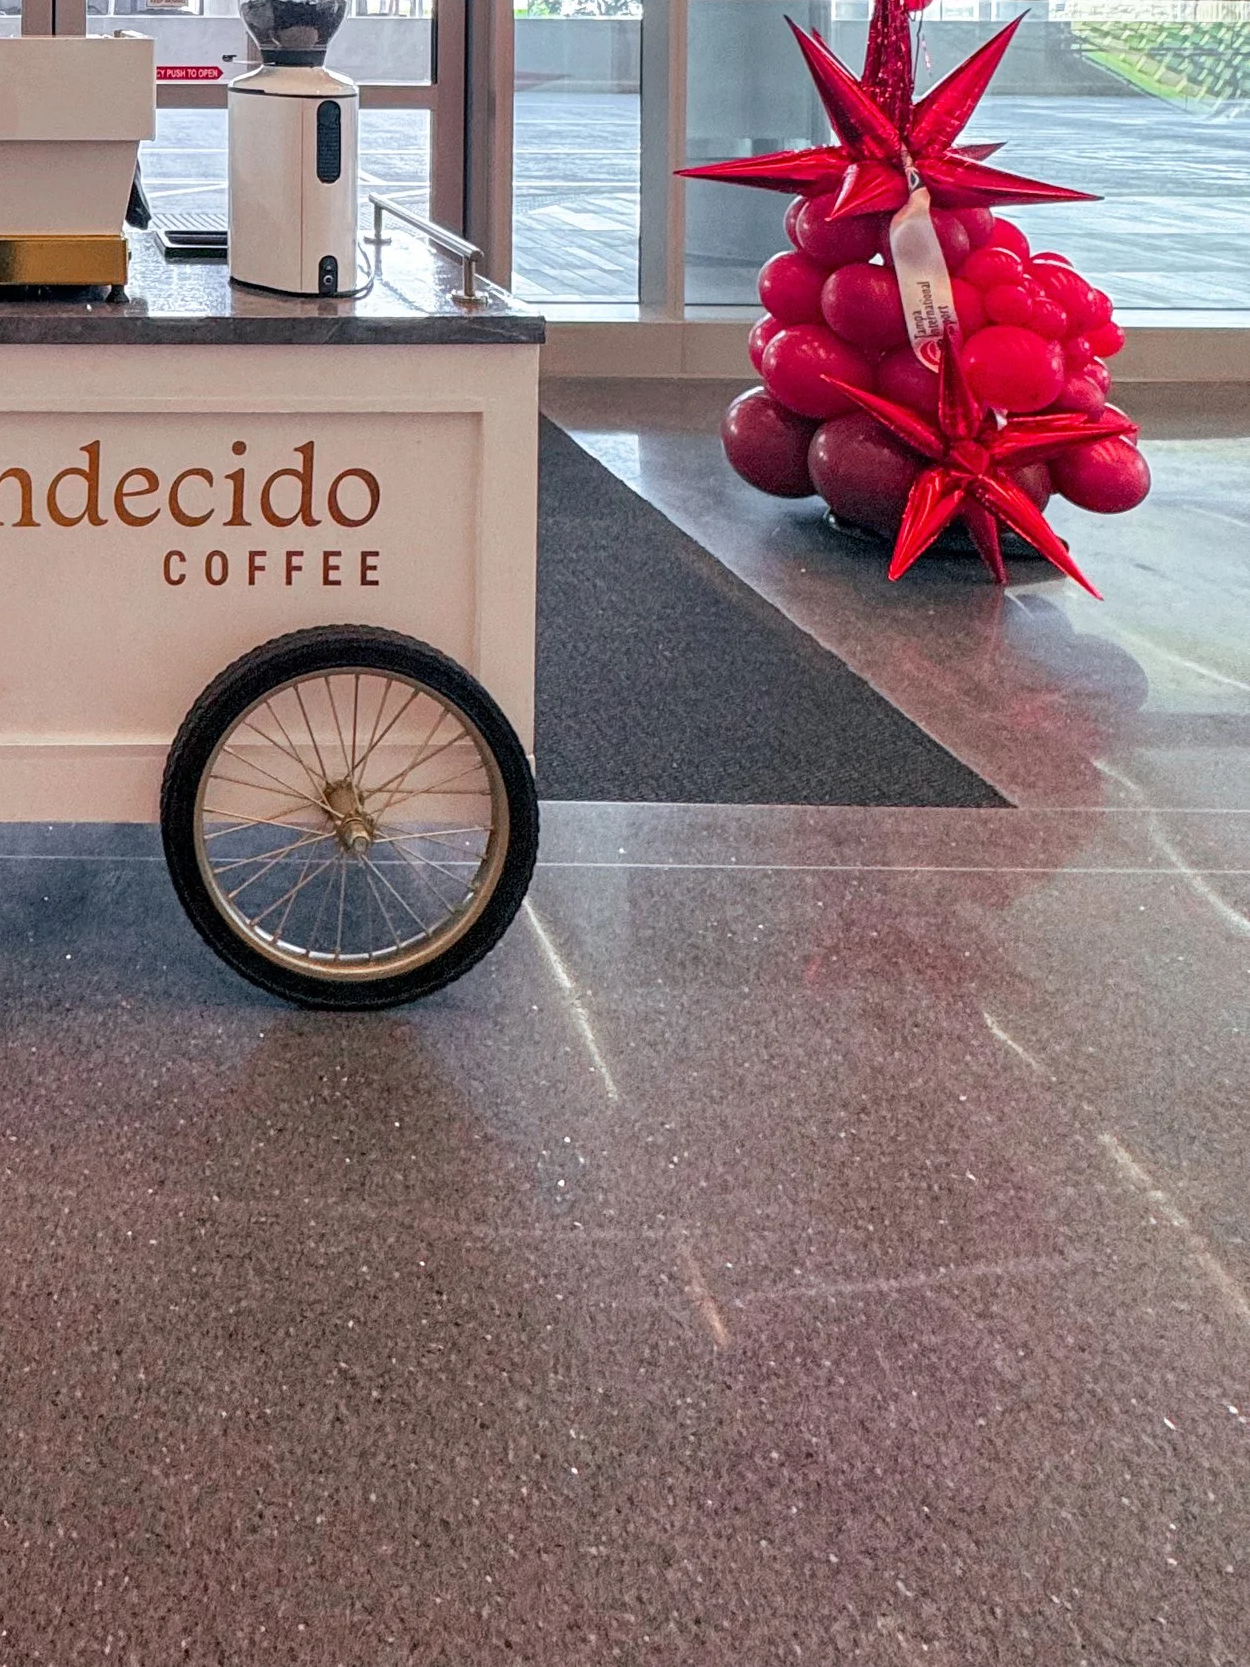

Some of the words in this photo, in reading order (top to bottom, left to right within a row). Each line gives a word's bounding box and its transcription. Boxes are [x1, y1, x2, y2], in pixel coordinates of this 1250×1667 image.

[166, 69, 186, 78] PUSH
[187, 69, 196, 78] TO
[198, 69, 218, 78] OPEN
[912, 310, 928, 338] Tampa
[916, 281, 943, 337] International
[163, 549, 381, 587] COFFEE
